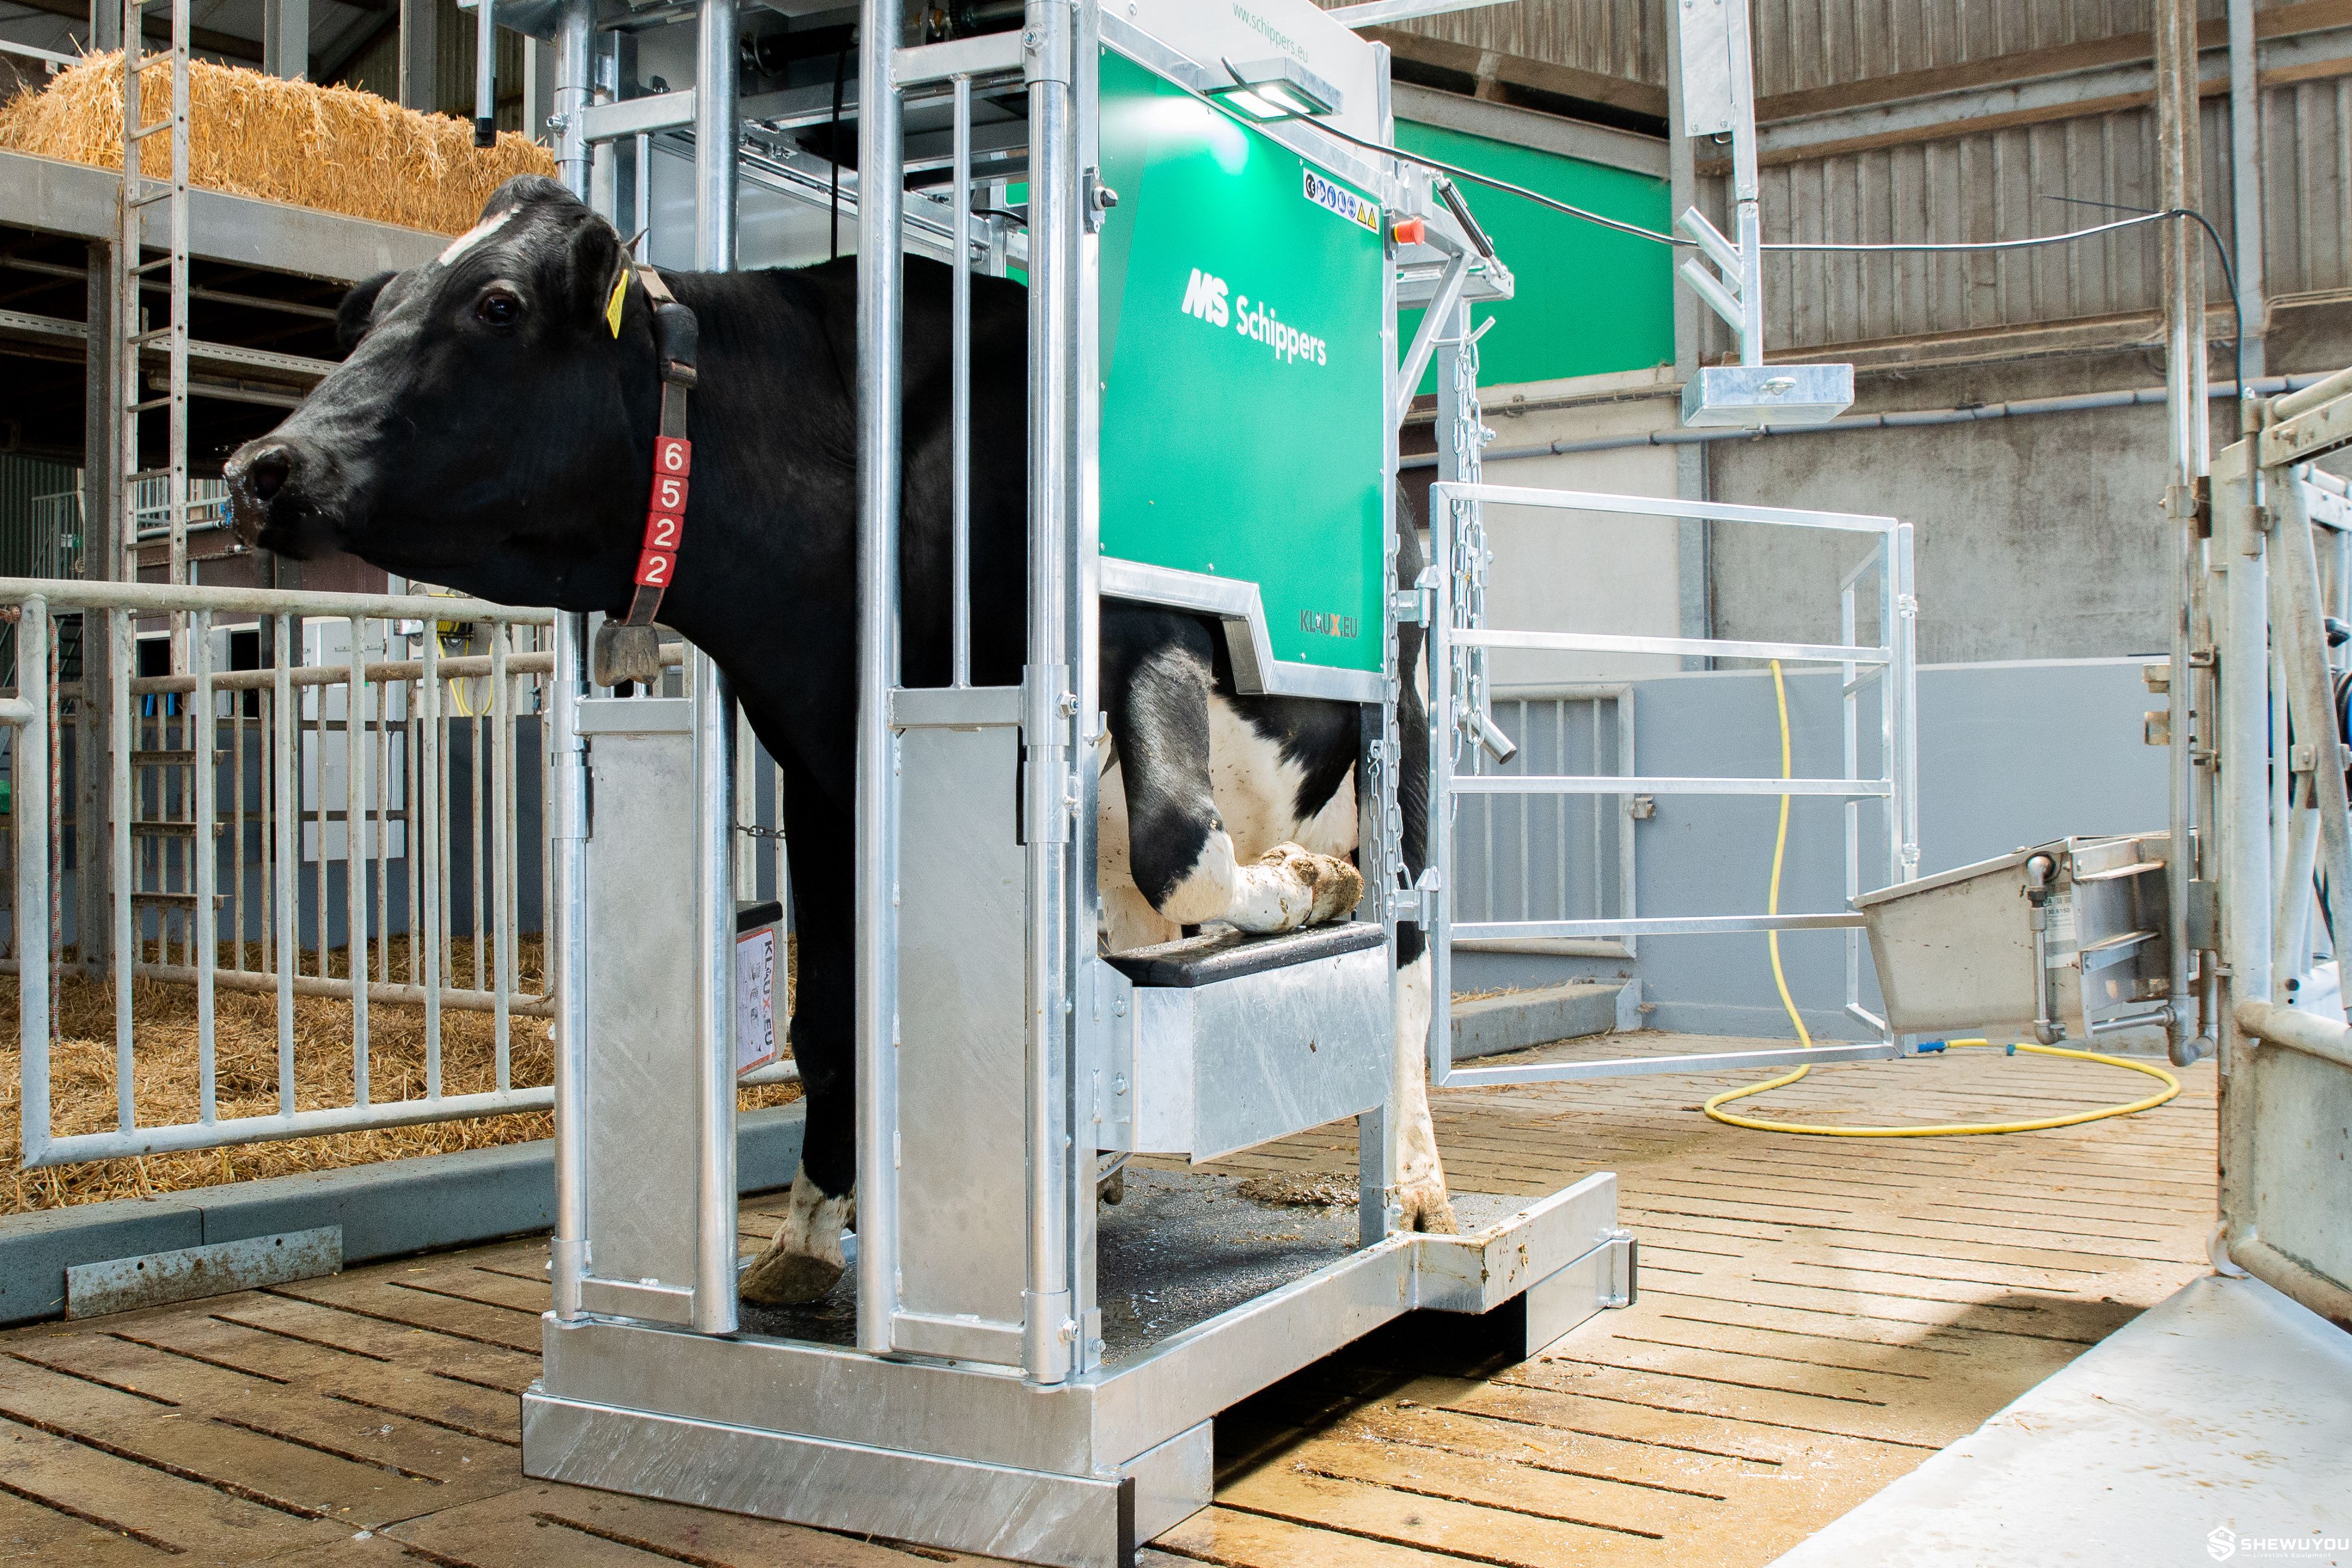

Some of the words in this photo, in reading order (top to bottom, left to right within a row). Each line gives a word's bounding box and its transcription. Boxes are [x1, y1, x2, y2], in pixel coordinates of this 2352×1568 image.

[1181, 268, 1229, 328] MS
[1236, 295, 1327, 366] Schippers
[1300, 609, 1358, 639] KLAUX.EU
